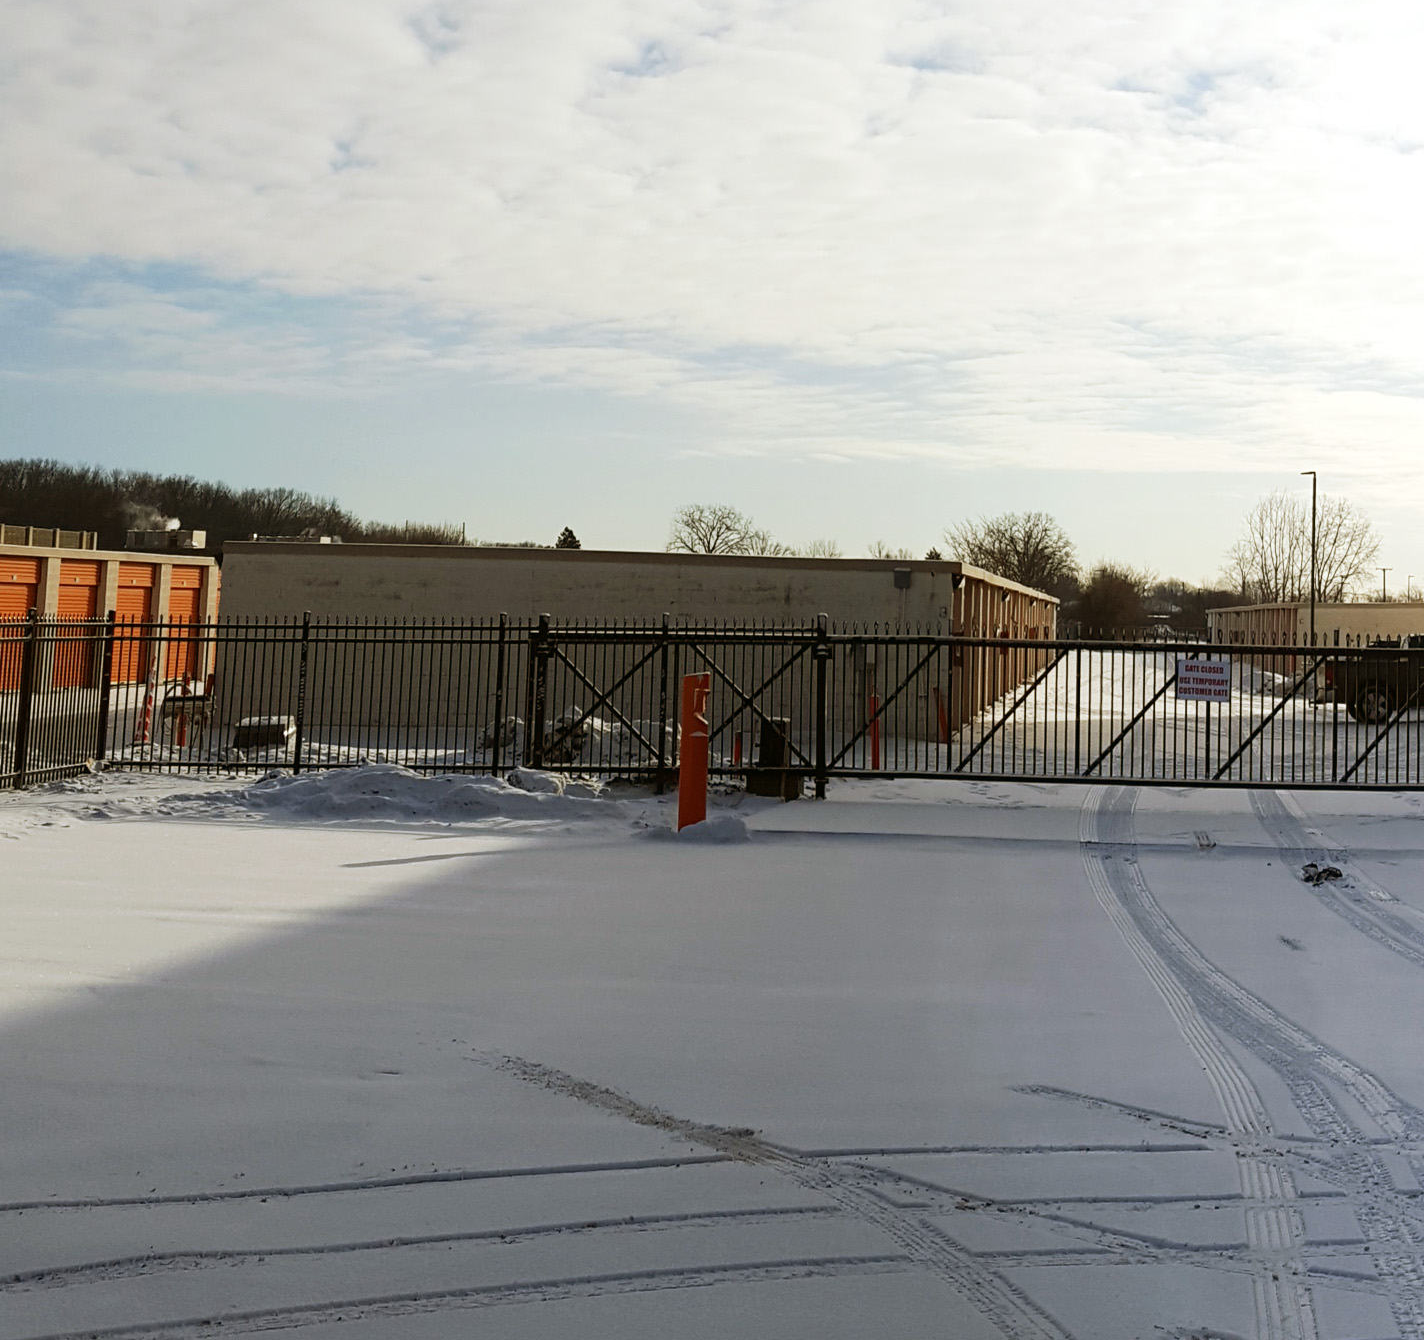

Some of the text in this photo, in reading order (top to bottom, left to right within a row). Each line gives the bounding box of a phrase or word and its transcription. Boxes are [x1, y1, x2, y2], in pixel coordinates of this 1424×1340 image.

[1185, 664, 1224, 674] GATE CLOSED
[1180, 676, 1228, 686] USE TEMPORARY
[1179, 687, 1228, 697] CUSTOMER GATE
